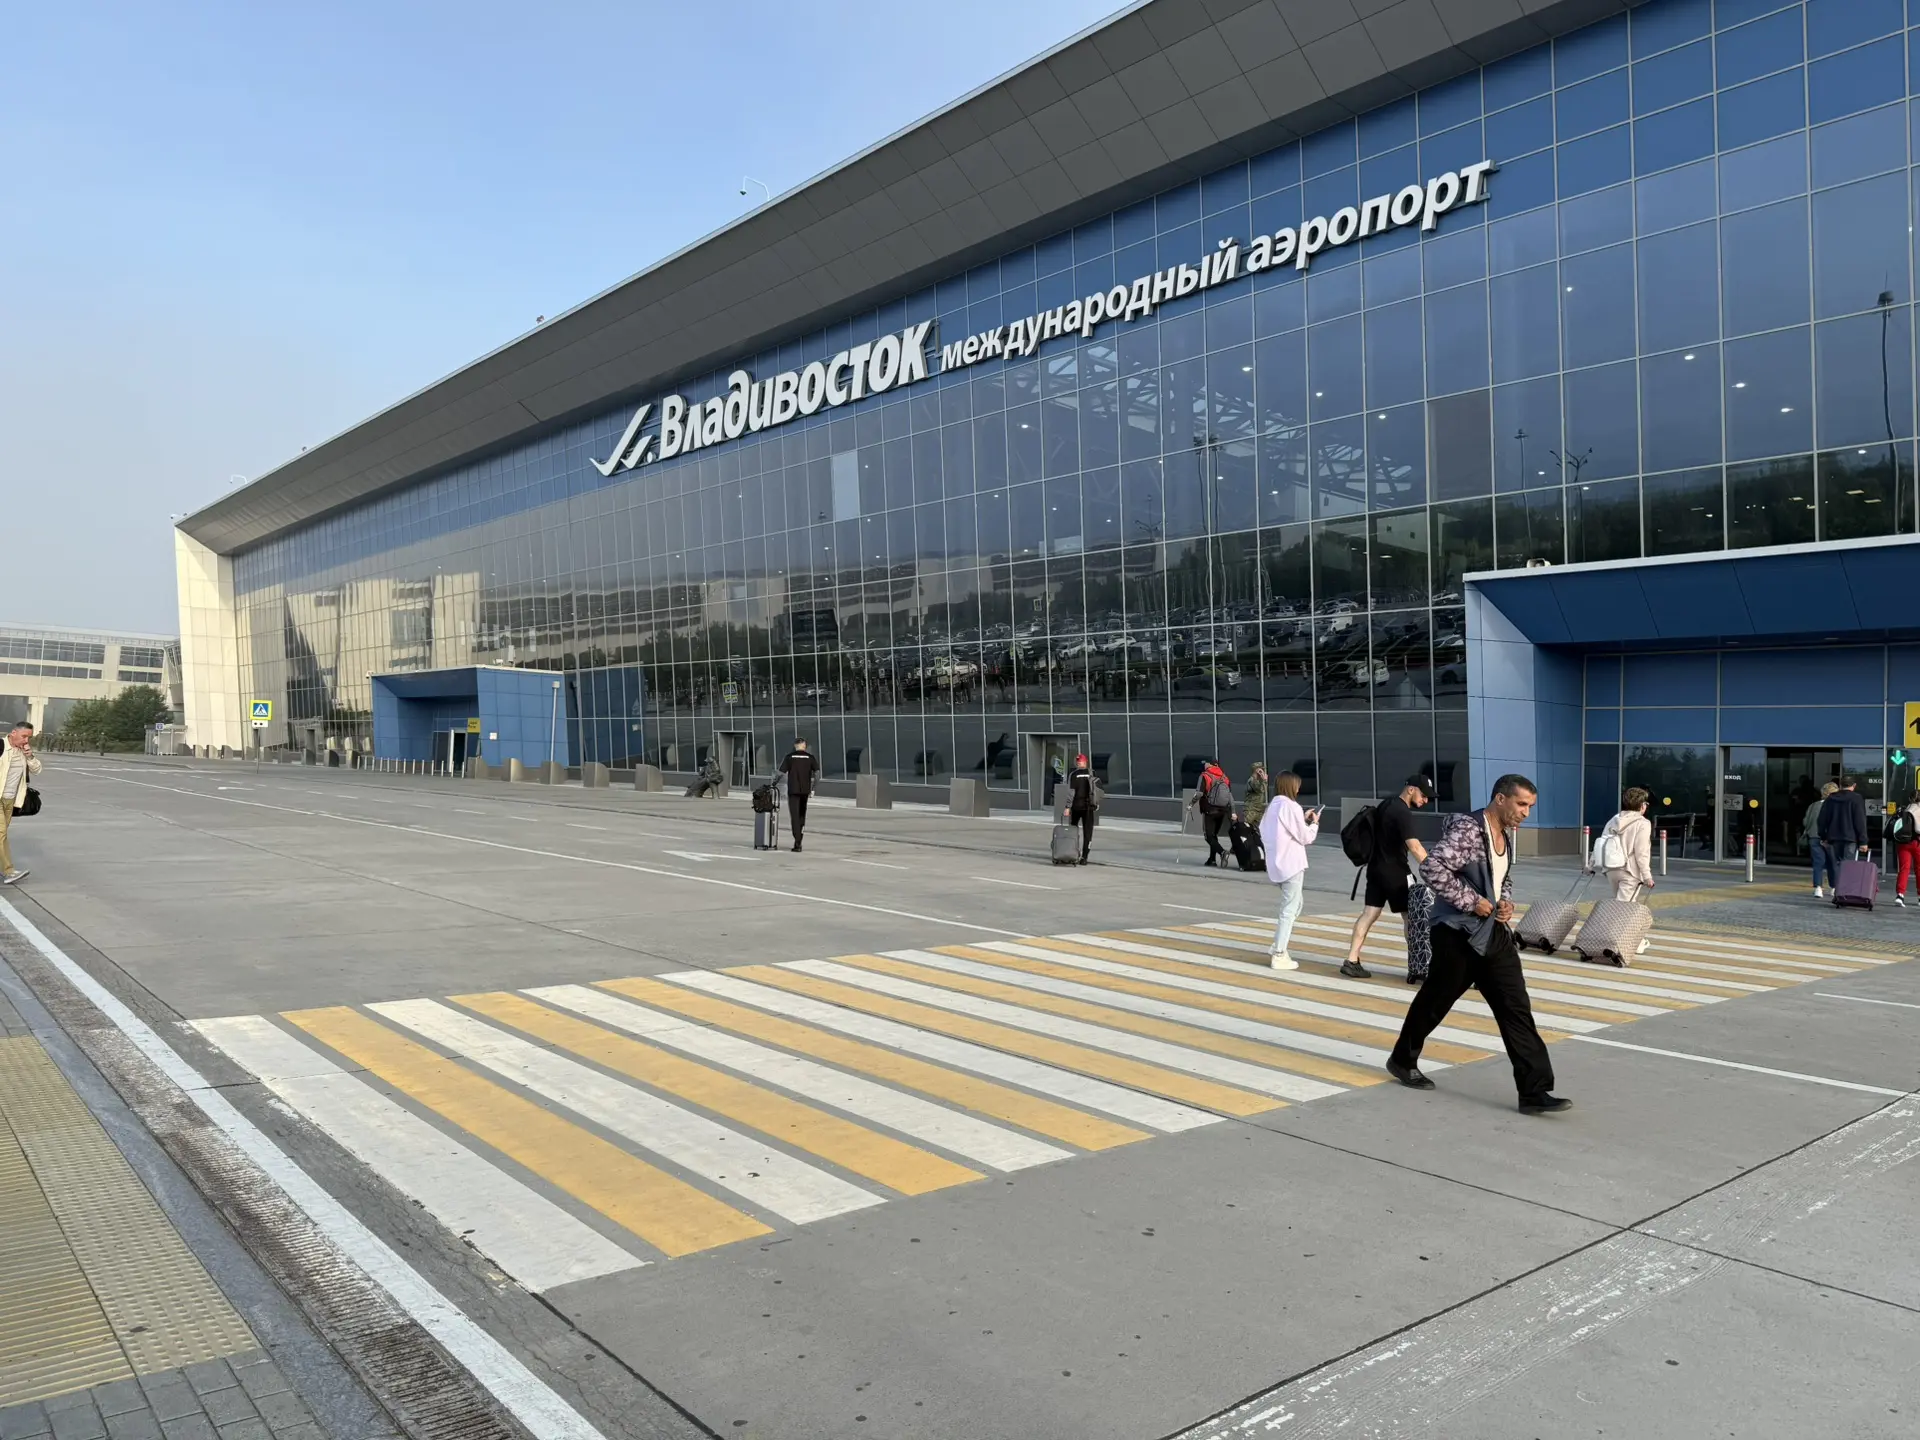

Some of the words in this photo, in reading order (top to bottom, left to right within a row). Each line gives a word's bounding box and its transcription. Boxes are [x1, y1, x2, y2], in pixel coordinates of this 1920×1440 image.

[658, 320, 937, 460] Владивосток
[940, 237, 1238, 372] международный
[1246, 159, 1497, 270] аэропорт
